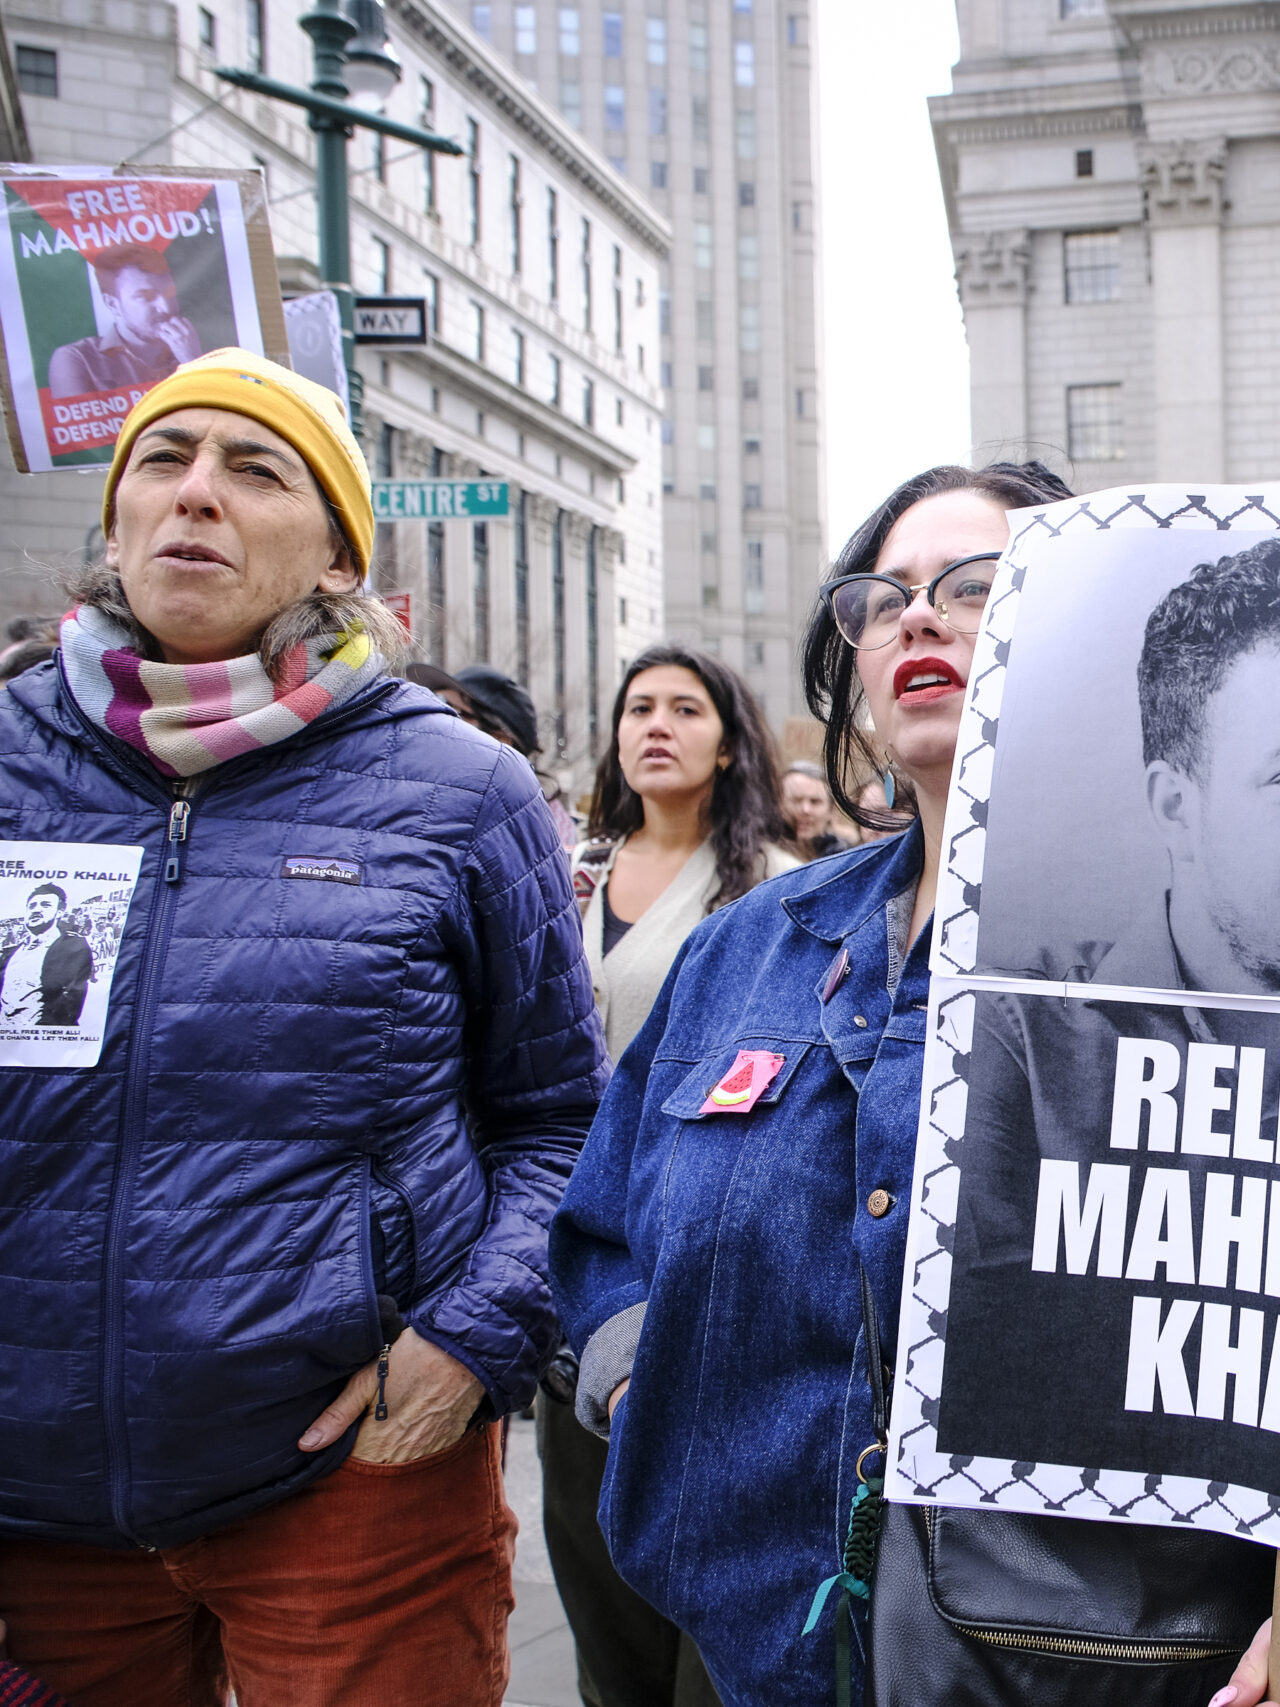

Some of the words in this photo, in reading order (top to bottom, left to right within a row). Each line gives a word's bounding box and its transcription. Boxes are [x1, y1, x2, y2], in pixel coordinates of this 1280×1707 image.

[65, 184, 146, 219] FREE
[19, 208, 215, 258] MAHMOUD!
[359, 312, 408, 329] WAY
[53, 396, 129, 424] DEFEND
[53, 417, 126, 445] DEFEND
[373, 484, 469, 516] CENTRE
[477, 484, 500, 502] ST
[74, 870, 132, 881] KHALIL
[290, 866, 353, 879] patagonia
